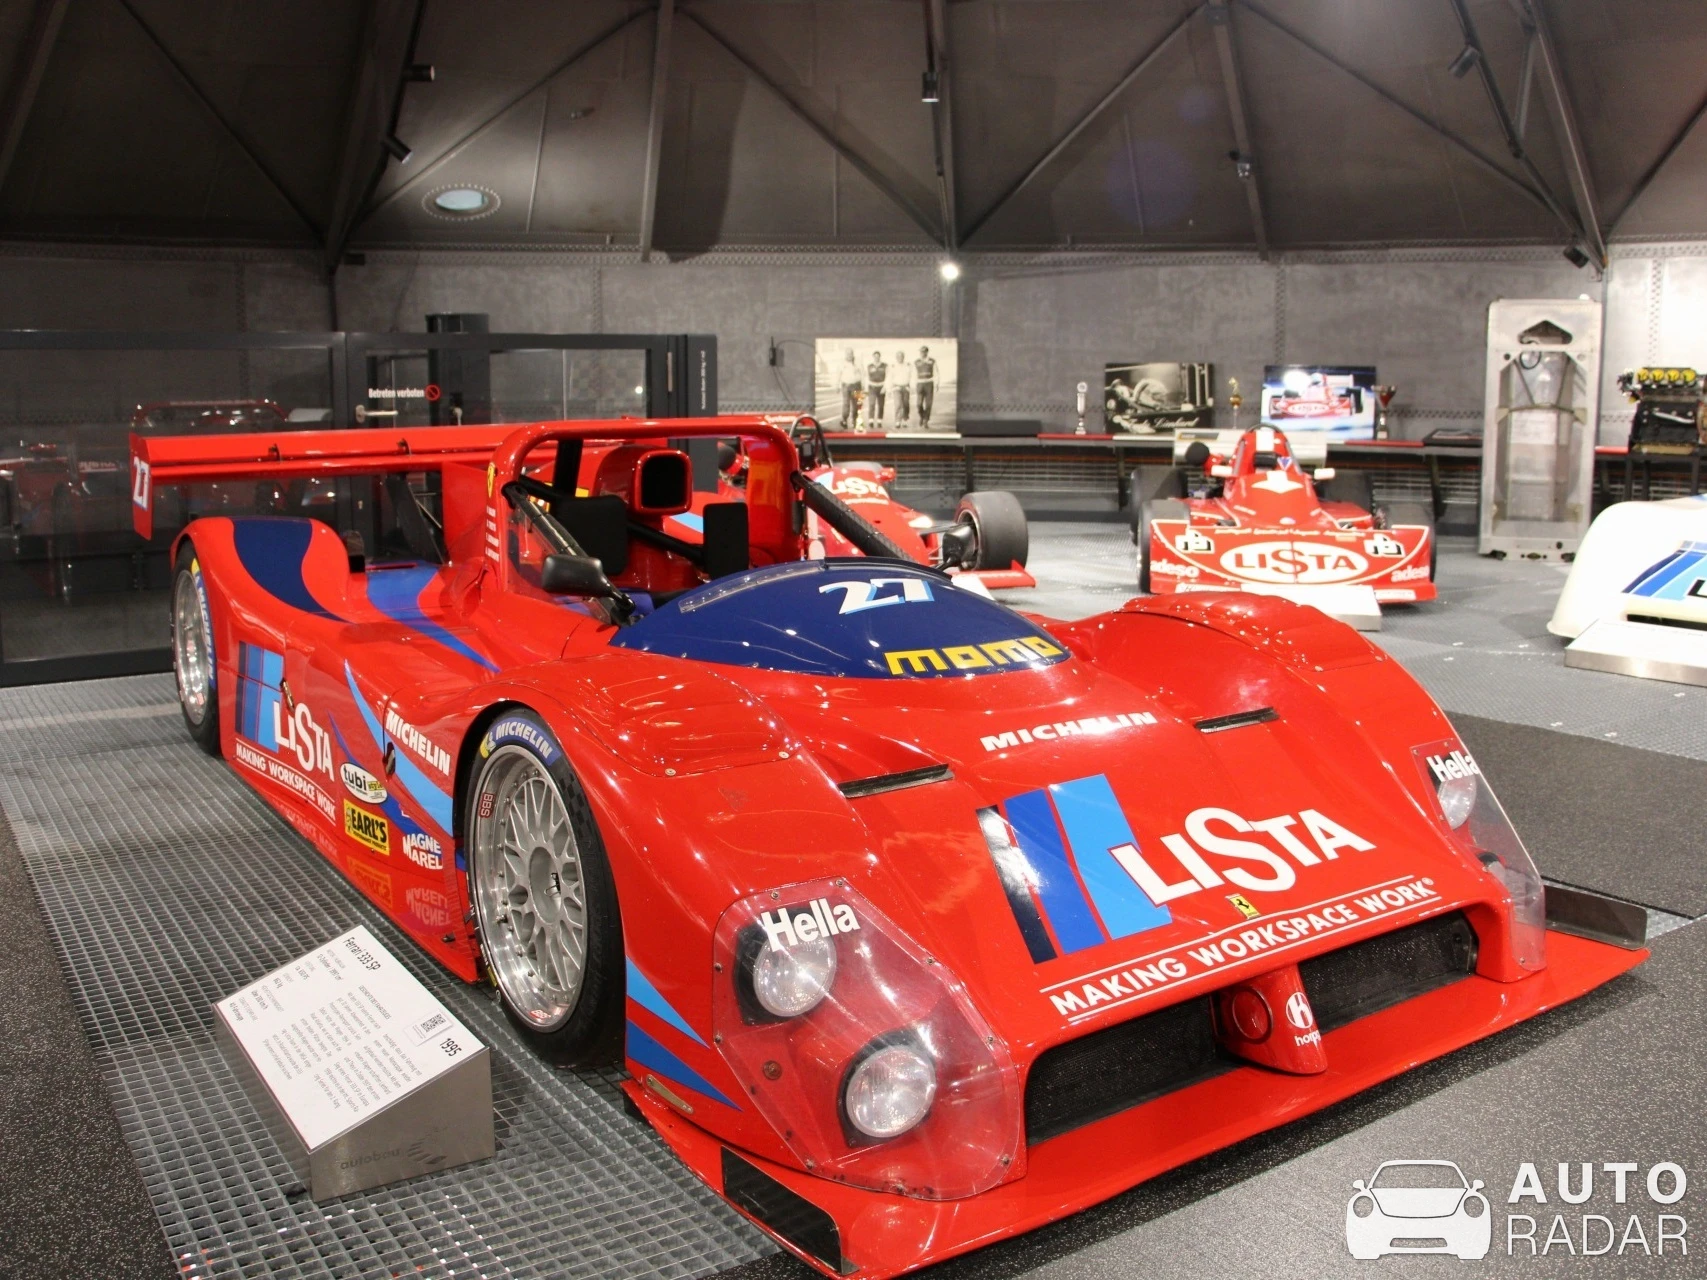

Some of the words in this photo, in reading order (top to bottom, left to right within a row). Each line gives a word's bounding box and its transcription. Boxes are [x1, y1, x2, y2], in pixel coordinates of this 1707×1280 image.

[369, 388, 395, 398] Betreten
[396, 388, 424, 398] verboten
[133, 456, 150, 511] 27
[1233, 549, 1358, 575] LISTA
[819, 578, 934, 615] 27
[884, 636, 1064, 675] momo
[274, 700, 334, 782] LISTA
[385, 709, 451, 776] MICHELIN
[496, 721, 553, 759] MICHELIN
[980, 711, 1158, 752] MICHELIN
[236, 742, 267, 772] MAKING
[268, 760, 316, 801] WORKSPACE
[316, 788, 337, 821] WORK
[343, 764, 367, 791] tubi
[1426, 750, 1480, 783] Hella
[480, 793, 494, 817] BBS
[351, 808, 388, 844] EARL'S
[1107, 807, 1376, 907] LISTA
[761, 898, 861, 952] Hella
[343, 936, 363, 957] Ferrari
[357, 952, 374, 965] 333
[366, 960, 381, 971] SP
[1048, 957, 1188, 1017] MAKING
[1187, 903, 1359, 967] WORKSPACE
[440, 1038, 462, 1057] 1995
